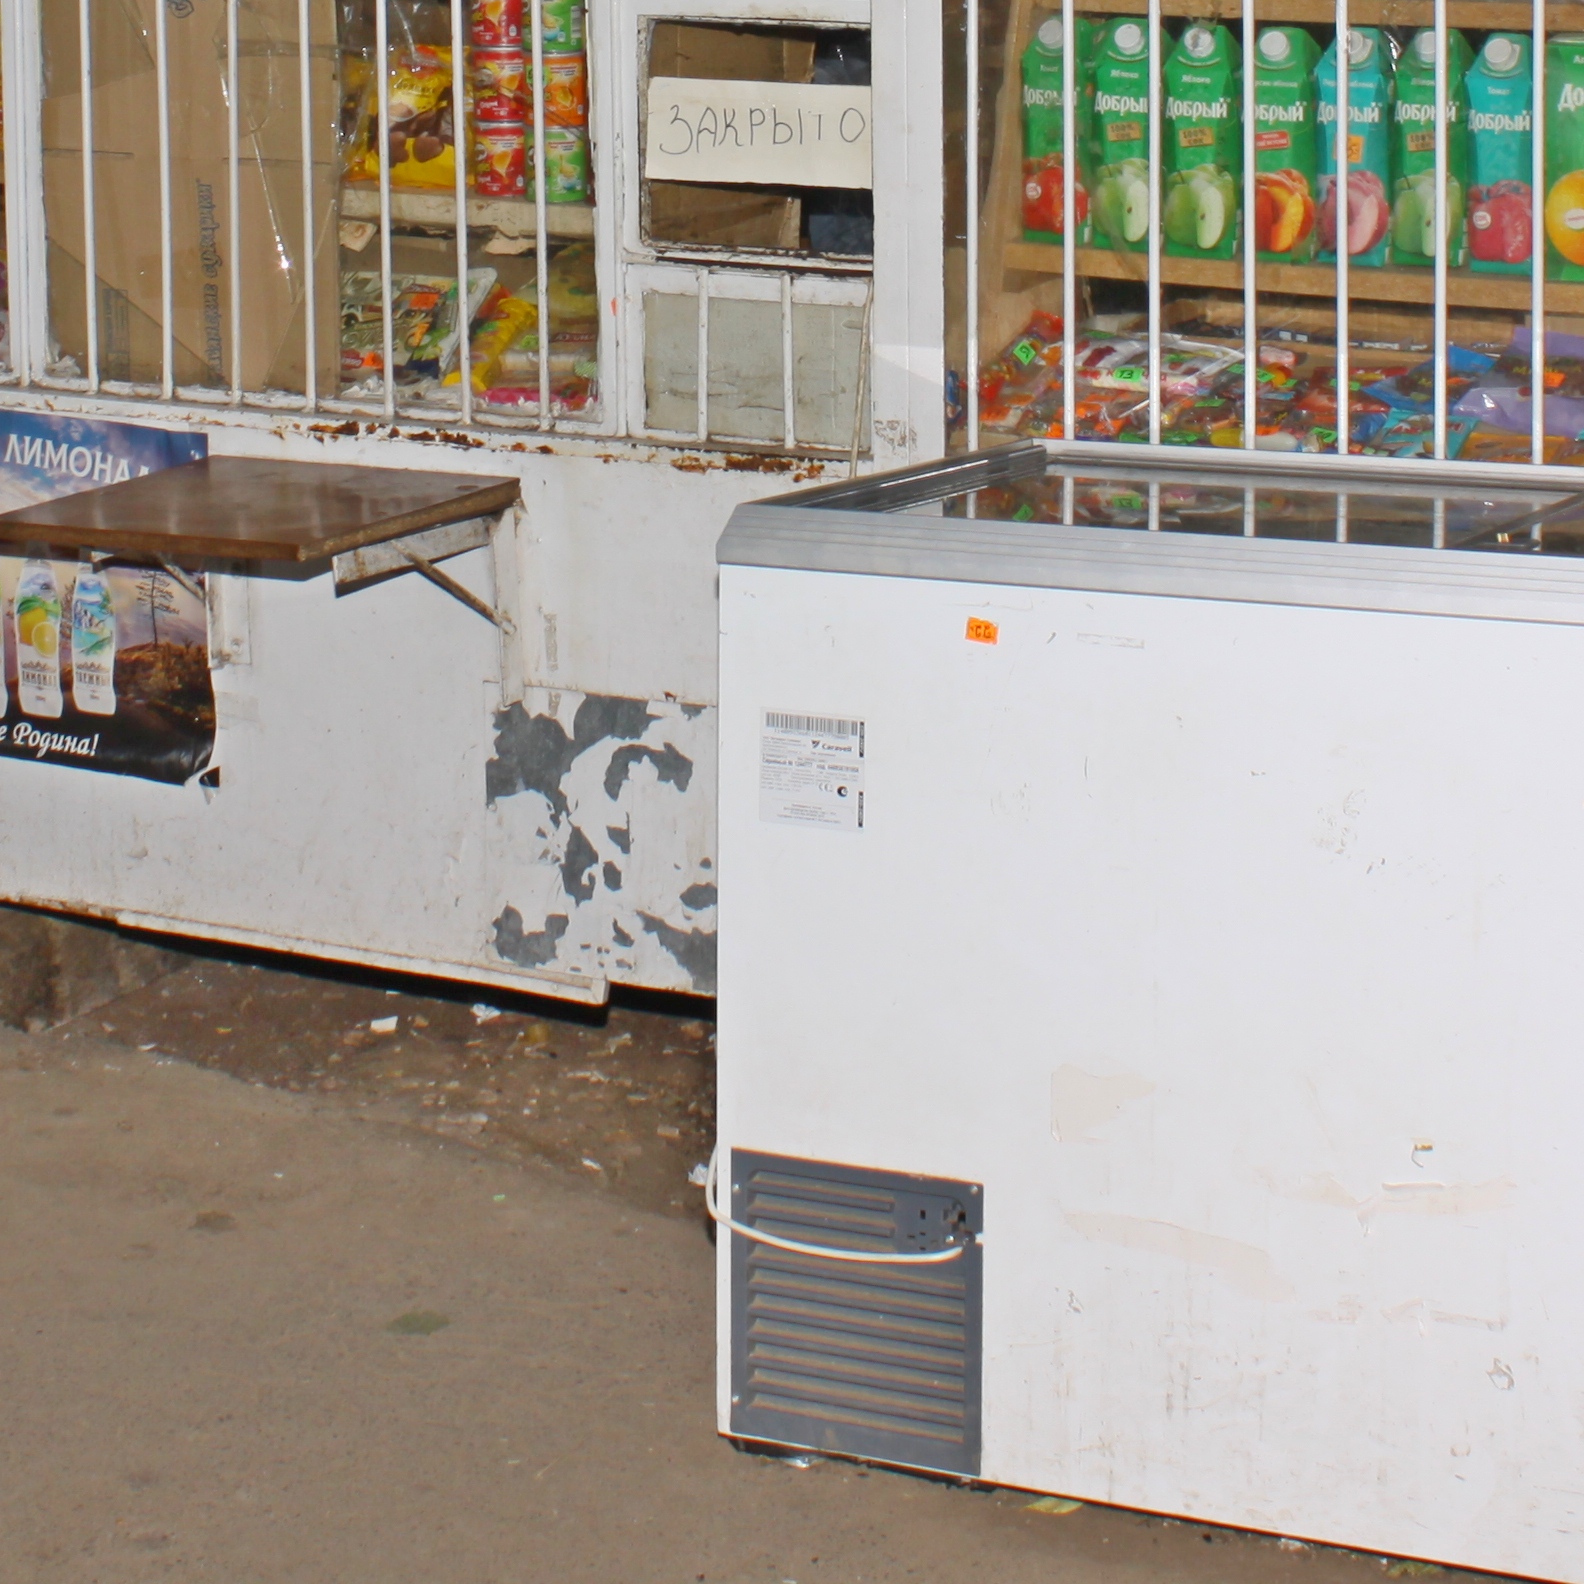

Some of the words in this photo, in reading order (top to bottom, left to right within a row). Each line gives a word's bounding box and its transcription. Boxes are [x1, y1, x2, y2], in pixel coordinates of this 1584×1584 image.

[1094, 90, 1148, 114] Добры
[1165, 96, 1232, 120] Добрый
[659, 103, 867, 154] ЗАКРЫТО
[4, 434, 151, 485] ЛИМОНА
[13, 722, 100, 758] Родина!
